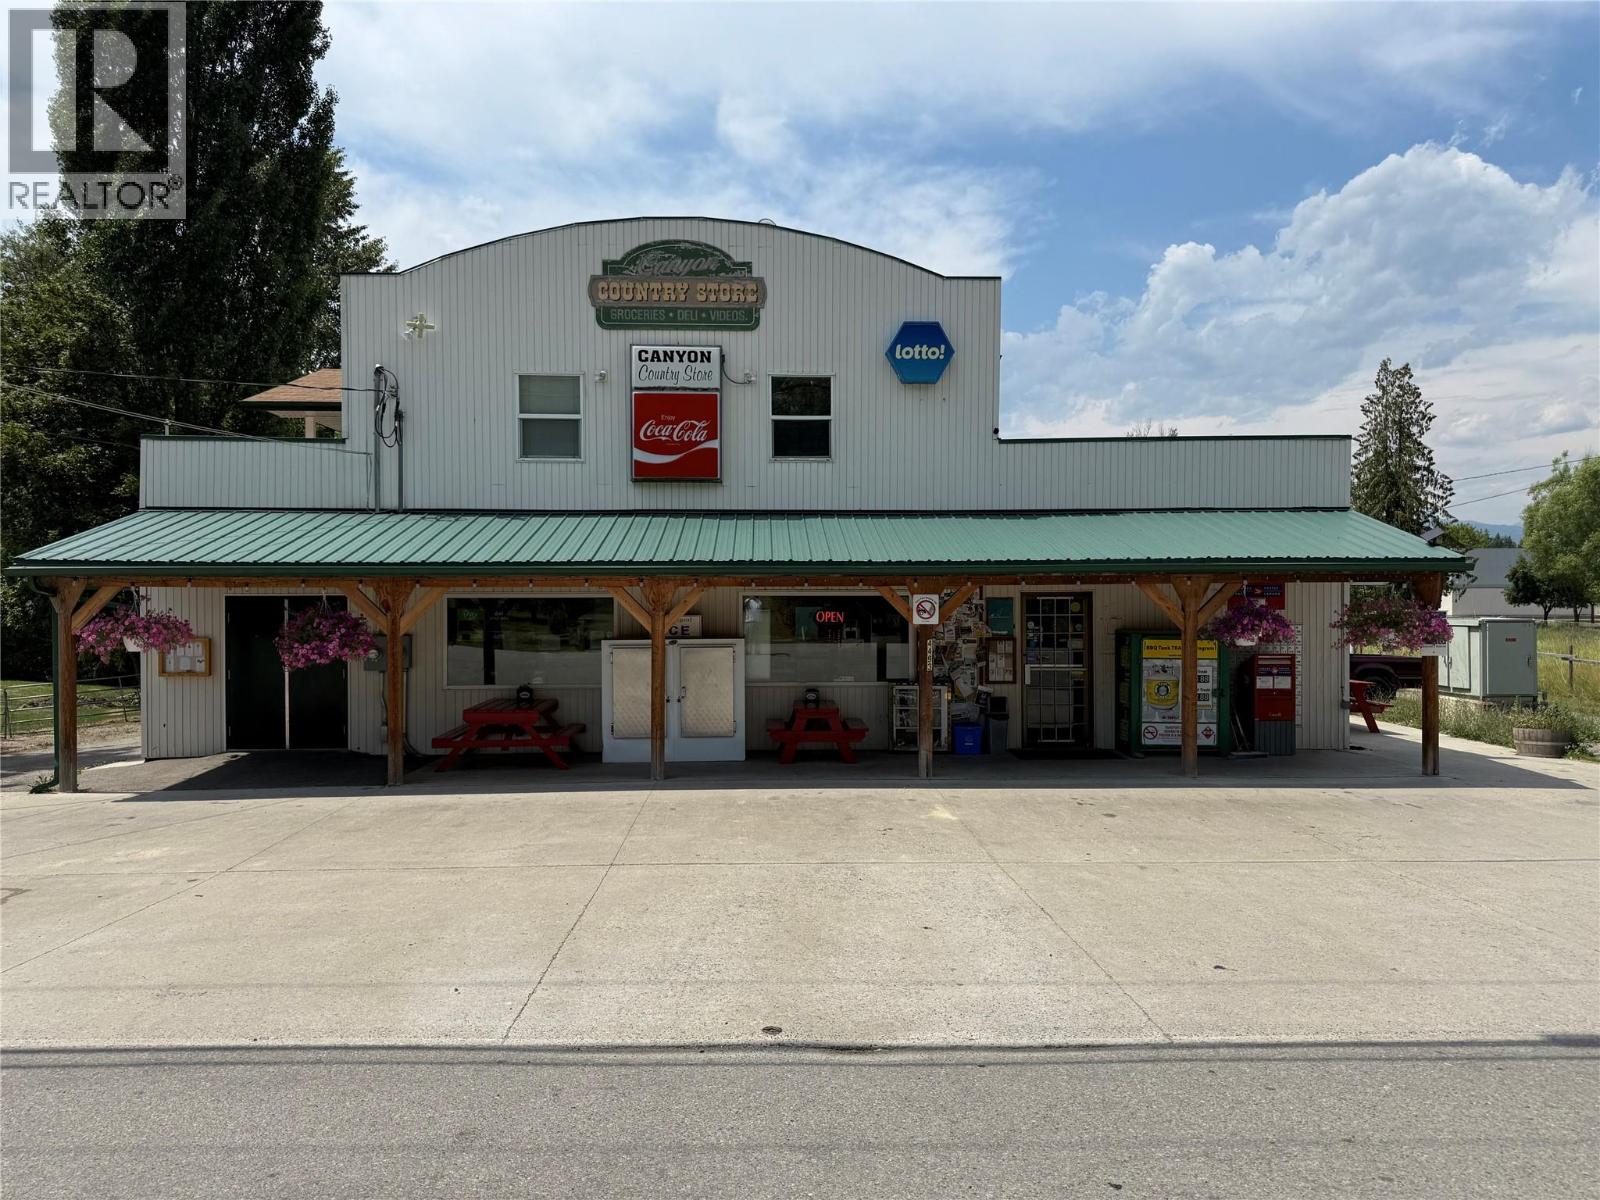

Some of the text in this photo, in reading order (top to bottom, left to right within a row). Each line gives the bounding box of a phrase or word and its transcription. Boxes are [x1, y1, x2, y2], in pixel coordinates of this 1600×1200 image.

[597, 281, 760, 304] COUNTRY STORE
[610, 309, 666, 321] GROCERIES
[677, 310, 698, 321] DELI
[638, 349, 712, 363] CANYON
[895, 344, 945, 360] lotto!
[638, 364, 713, 385] Country Store
[816, 611, 845, 623] OPEN
